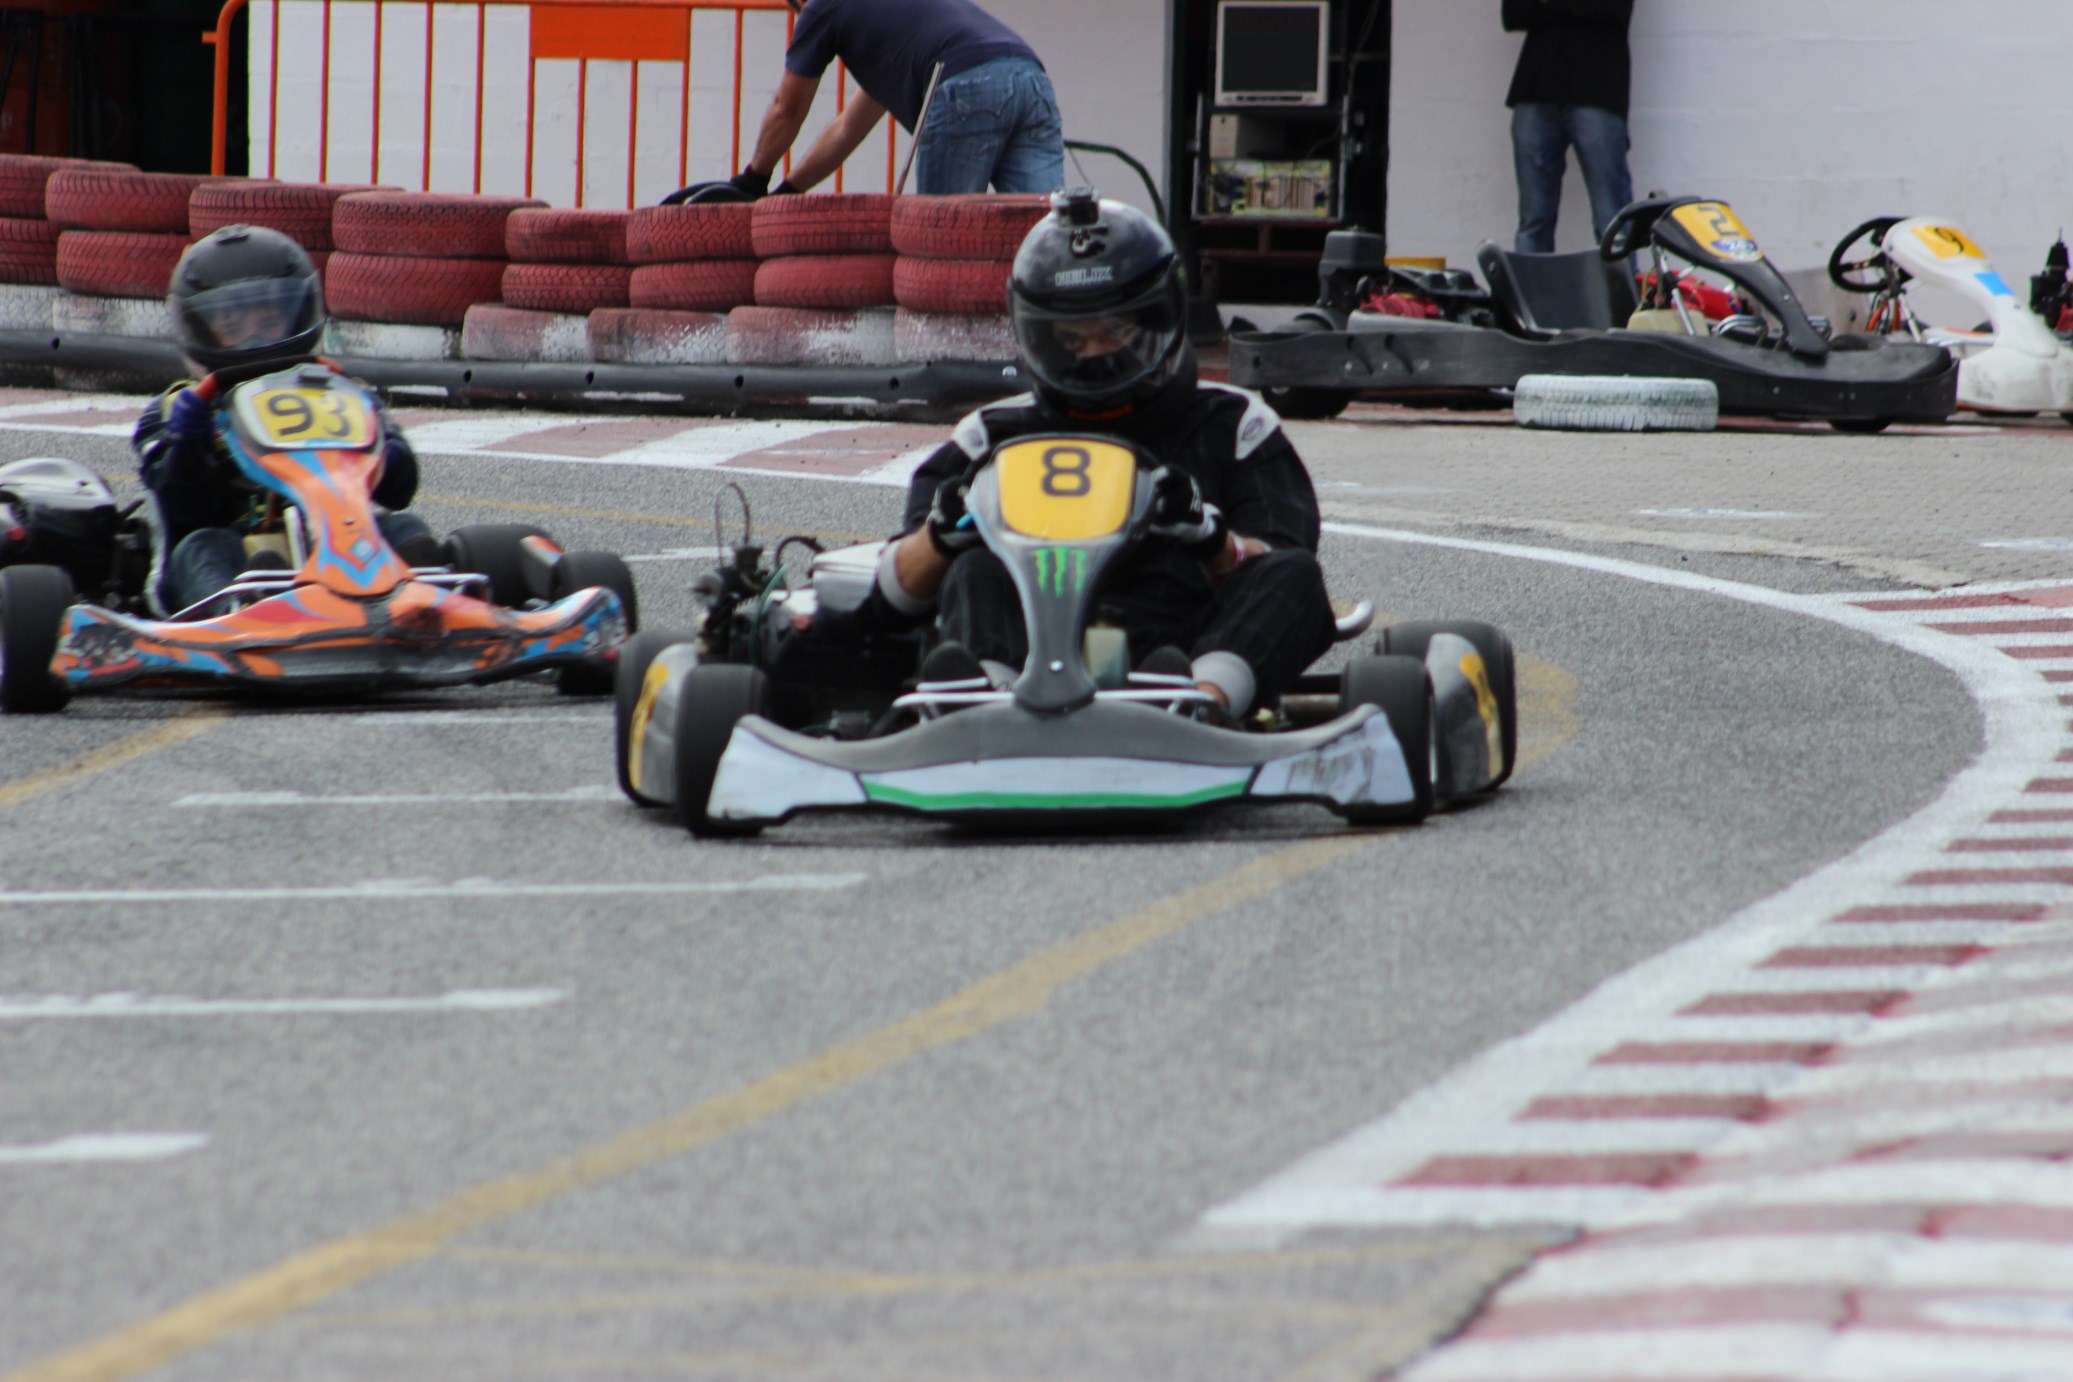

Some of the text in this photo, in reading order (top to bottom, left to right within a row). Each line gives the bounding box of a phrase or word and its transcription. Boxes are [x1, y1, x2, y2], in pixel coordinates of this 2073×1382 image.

[1697, 205, 1739, 237] 2
[1934, 227, 1964, 253] 9
[267, 393, 352, 437] 93
[1041, 446, 1092, 497] 8
